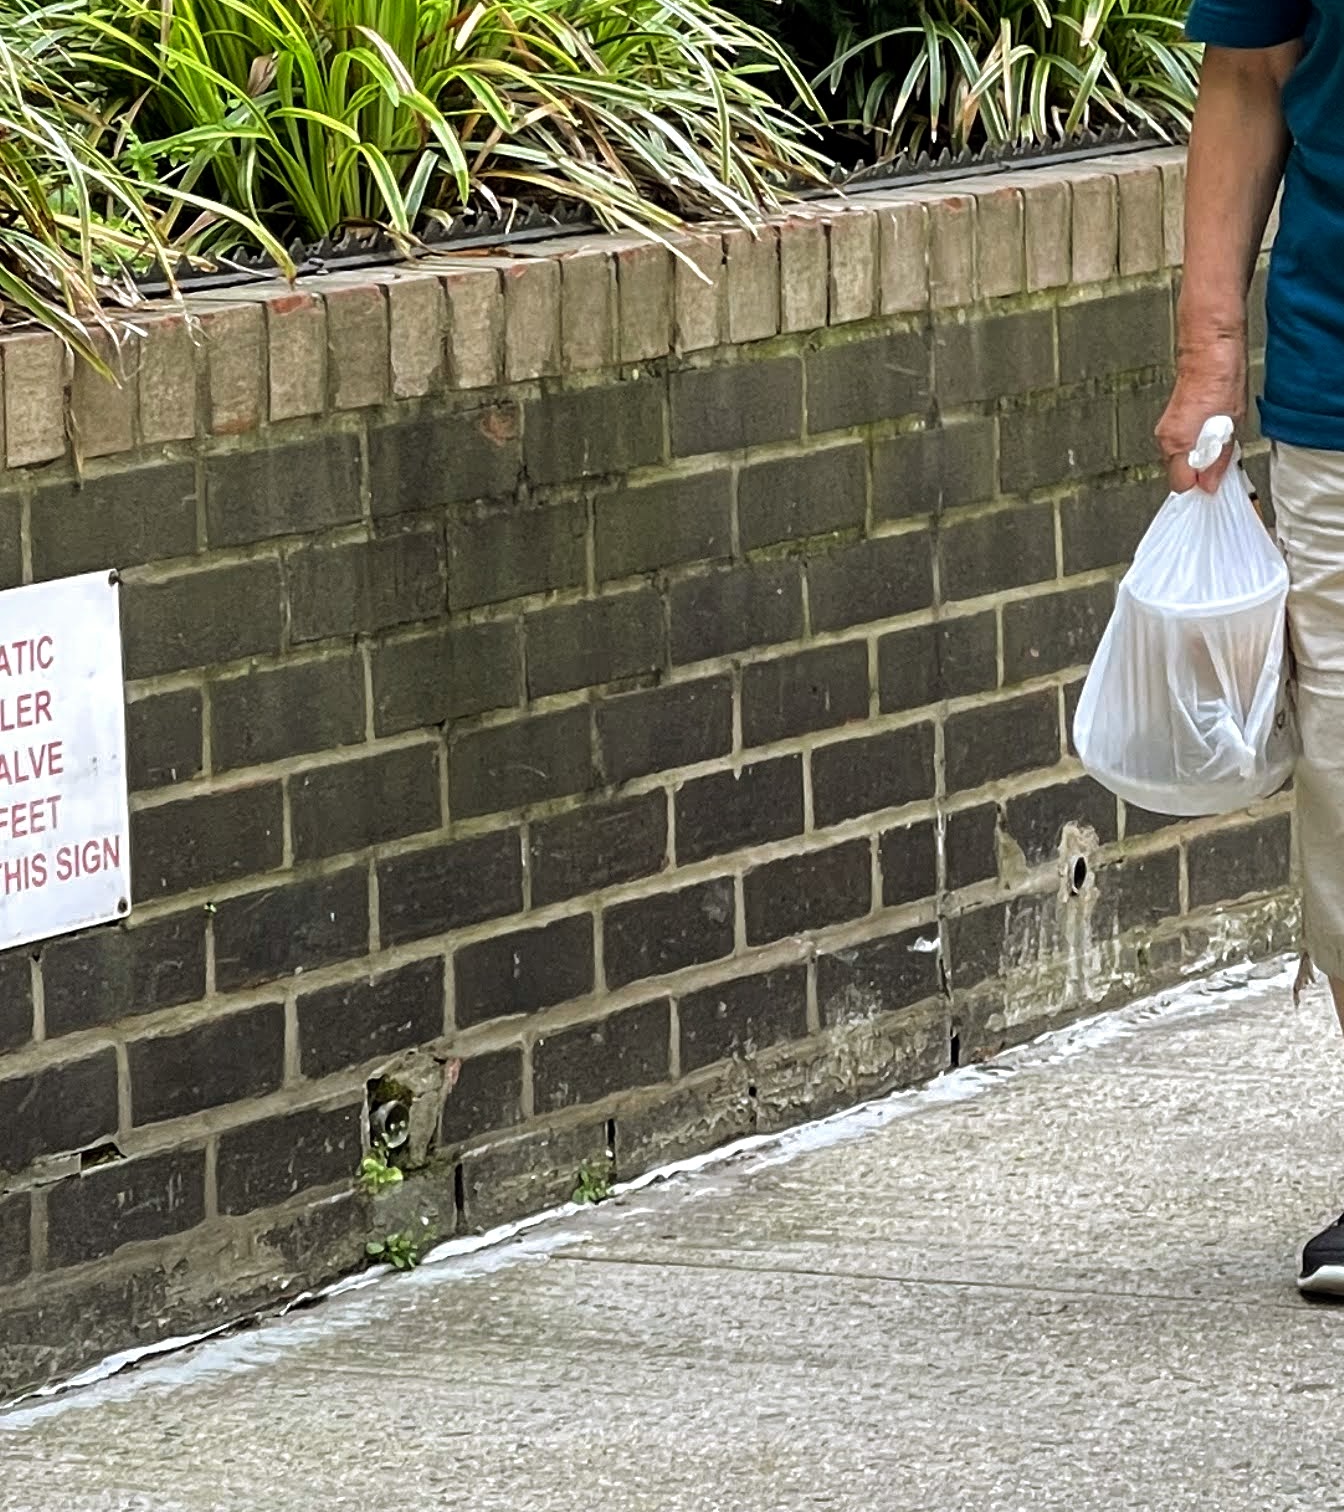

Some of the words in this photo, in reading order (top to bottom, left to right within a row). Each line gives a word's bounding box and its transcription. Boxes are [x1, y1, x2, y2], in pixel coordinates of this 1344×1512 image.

[0, 690, 53, 732] LER
[0, 852, 47, 895] HIS
[57, 835, 120, 881] SIGN
